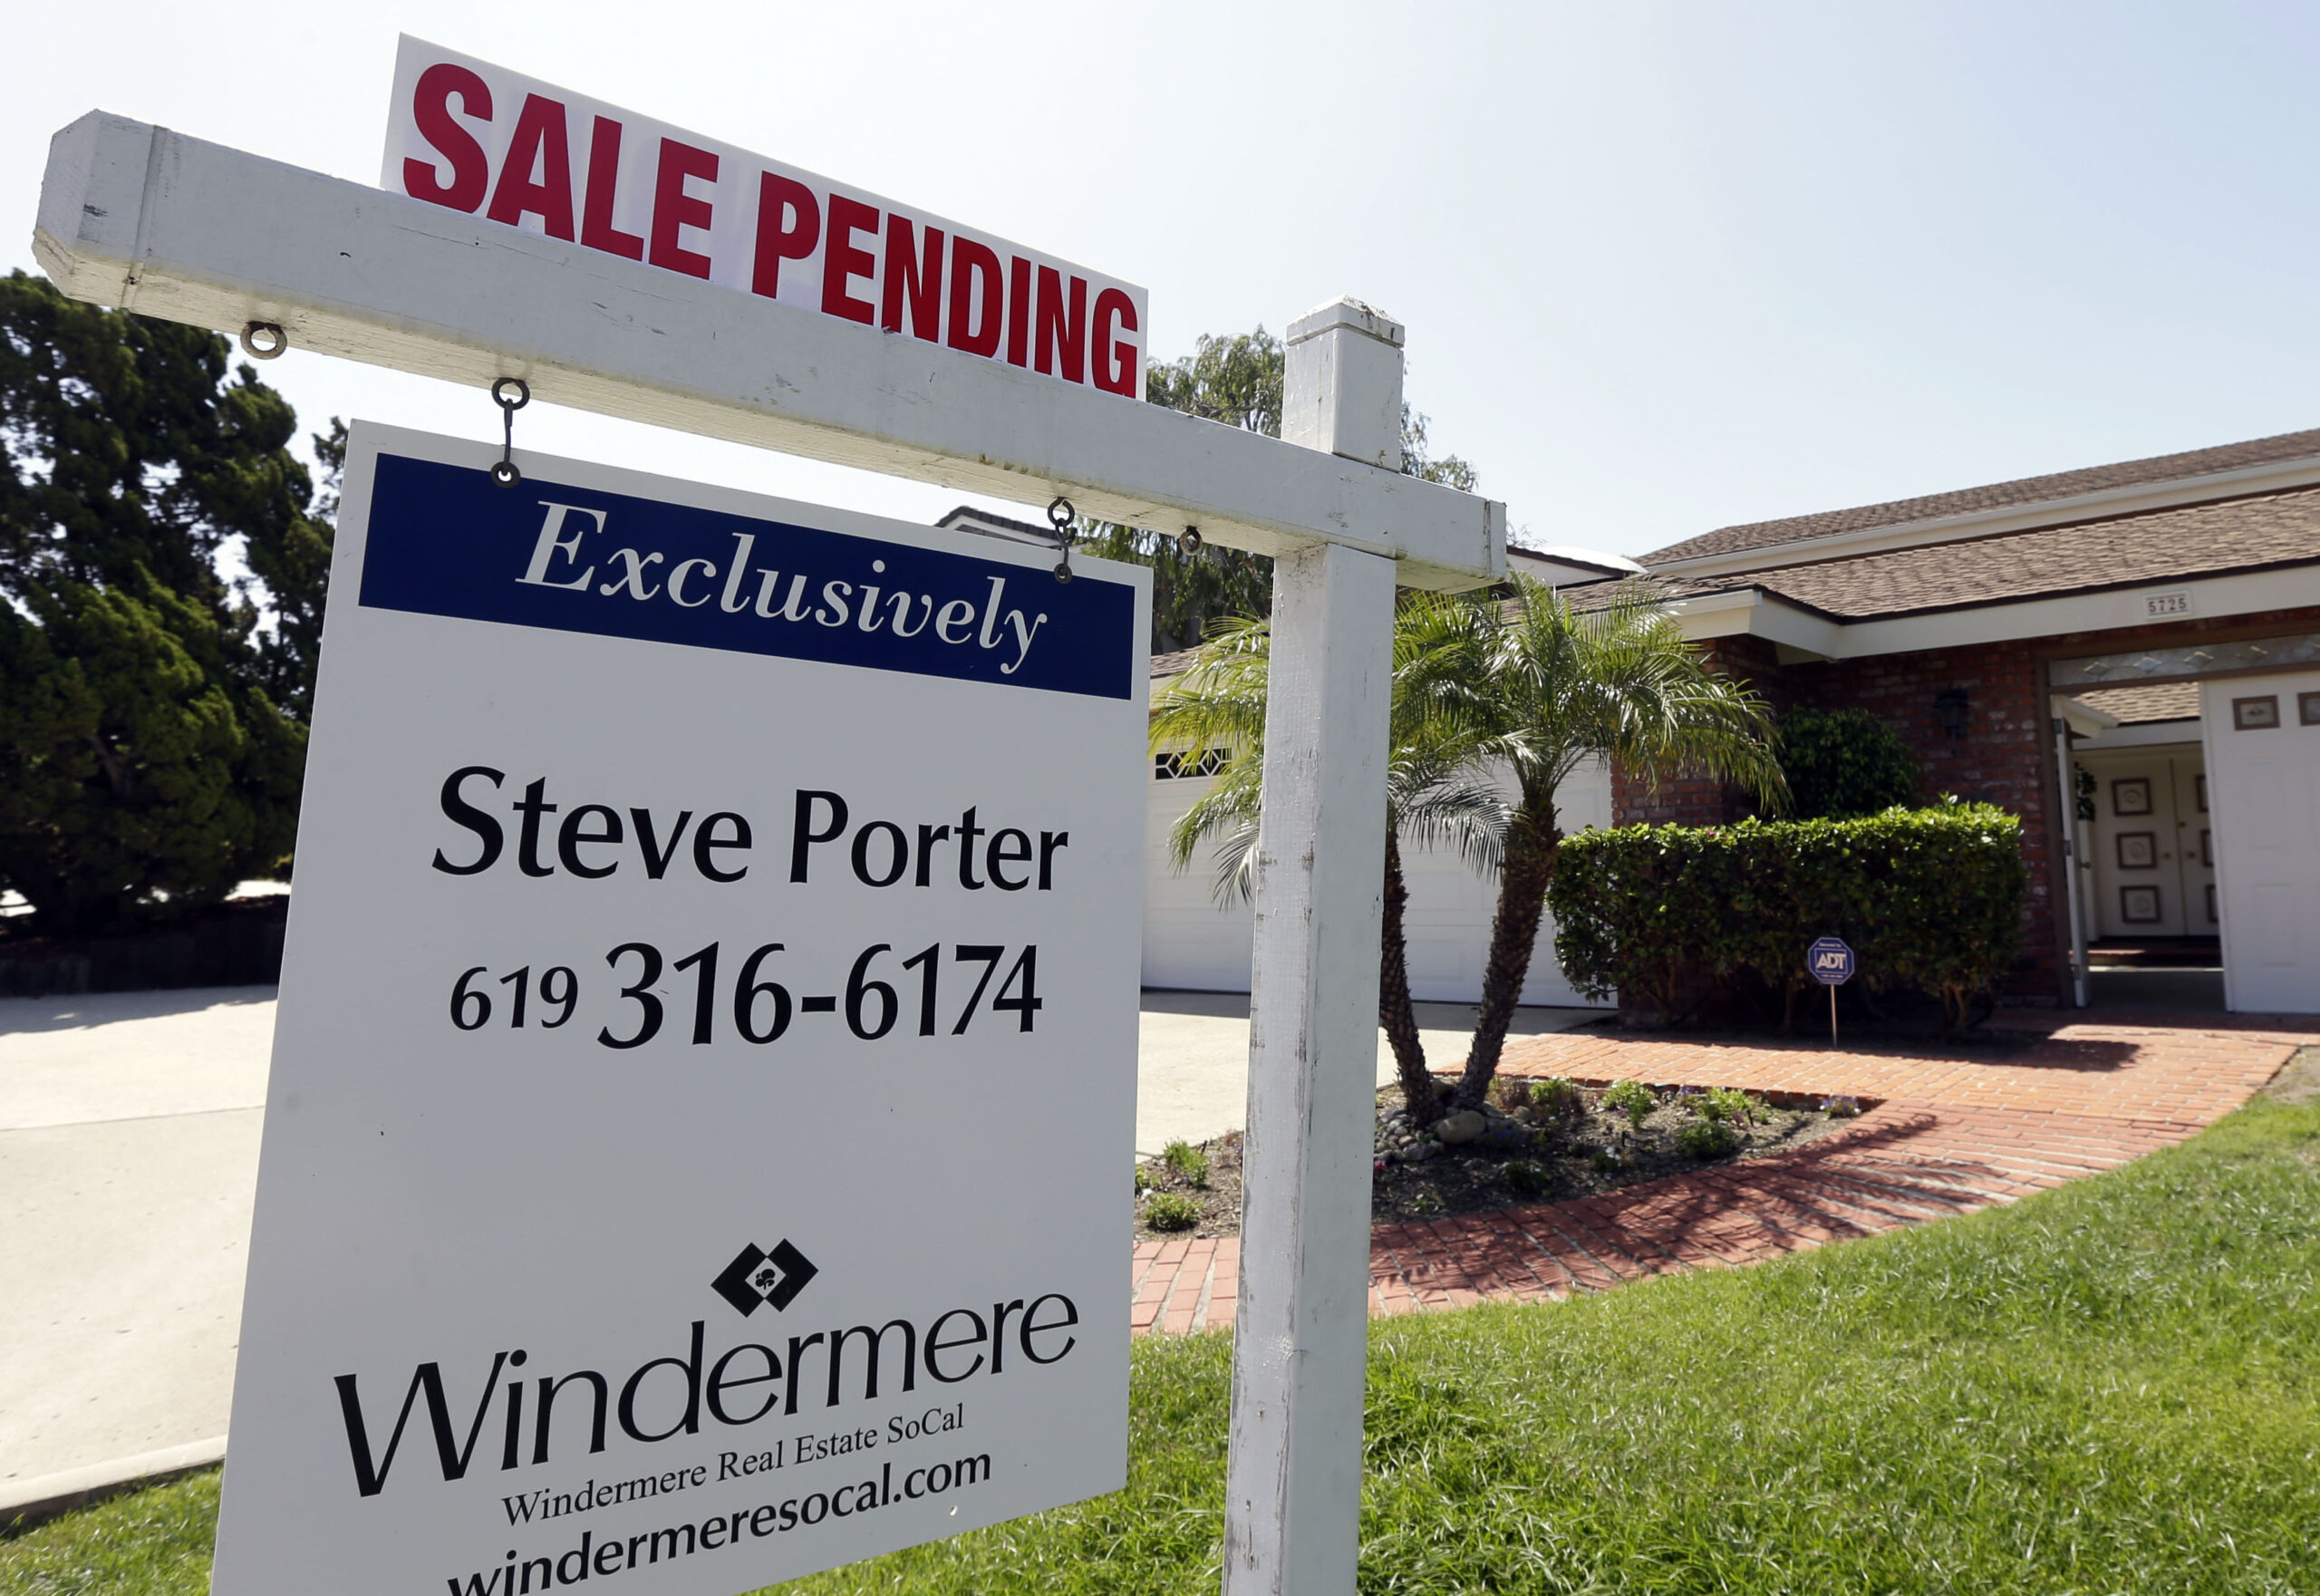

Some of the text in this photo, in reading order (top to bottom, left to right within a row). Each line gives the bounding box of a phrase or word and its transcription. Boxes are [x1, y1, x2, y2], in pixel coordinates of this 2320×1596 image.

[402, 63, 1138, 400] SALE PENDING
[515, 499, 1049, 674] Exclusively
[2148, 597, 2187, 613] 5725
[431, 765, 1070, 893] Steve Porter
[449, 941, 1044, 1050] 619 316-6174
[1816, 953, 1846, 969] ADT
[333, 1293, 1079, 1499] Windermere
[446, 1453, 993, 1596] windermeresocal.com
[501, 1402, 965, 1528] Windermere Real Estate SoCal
